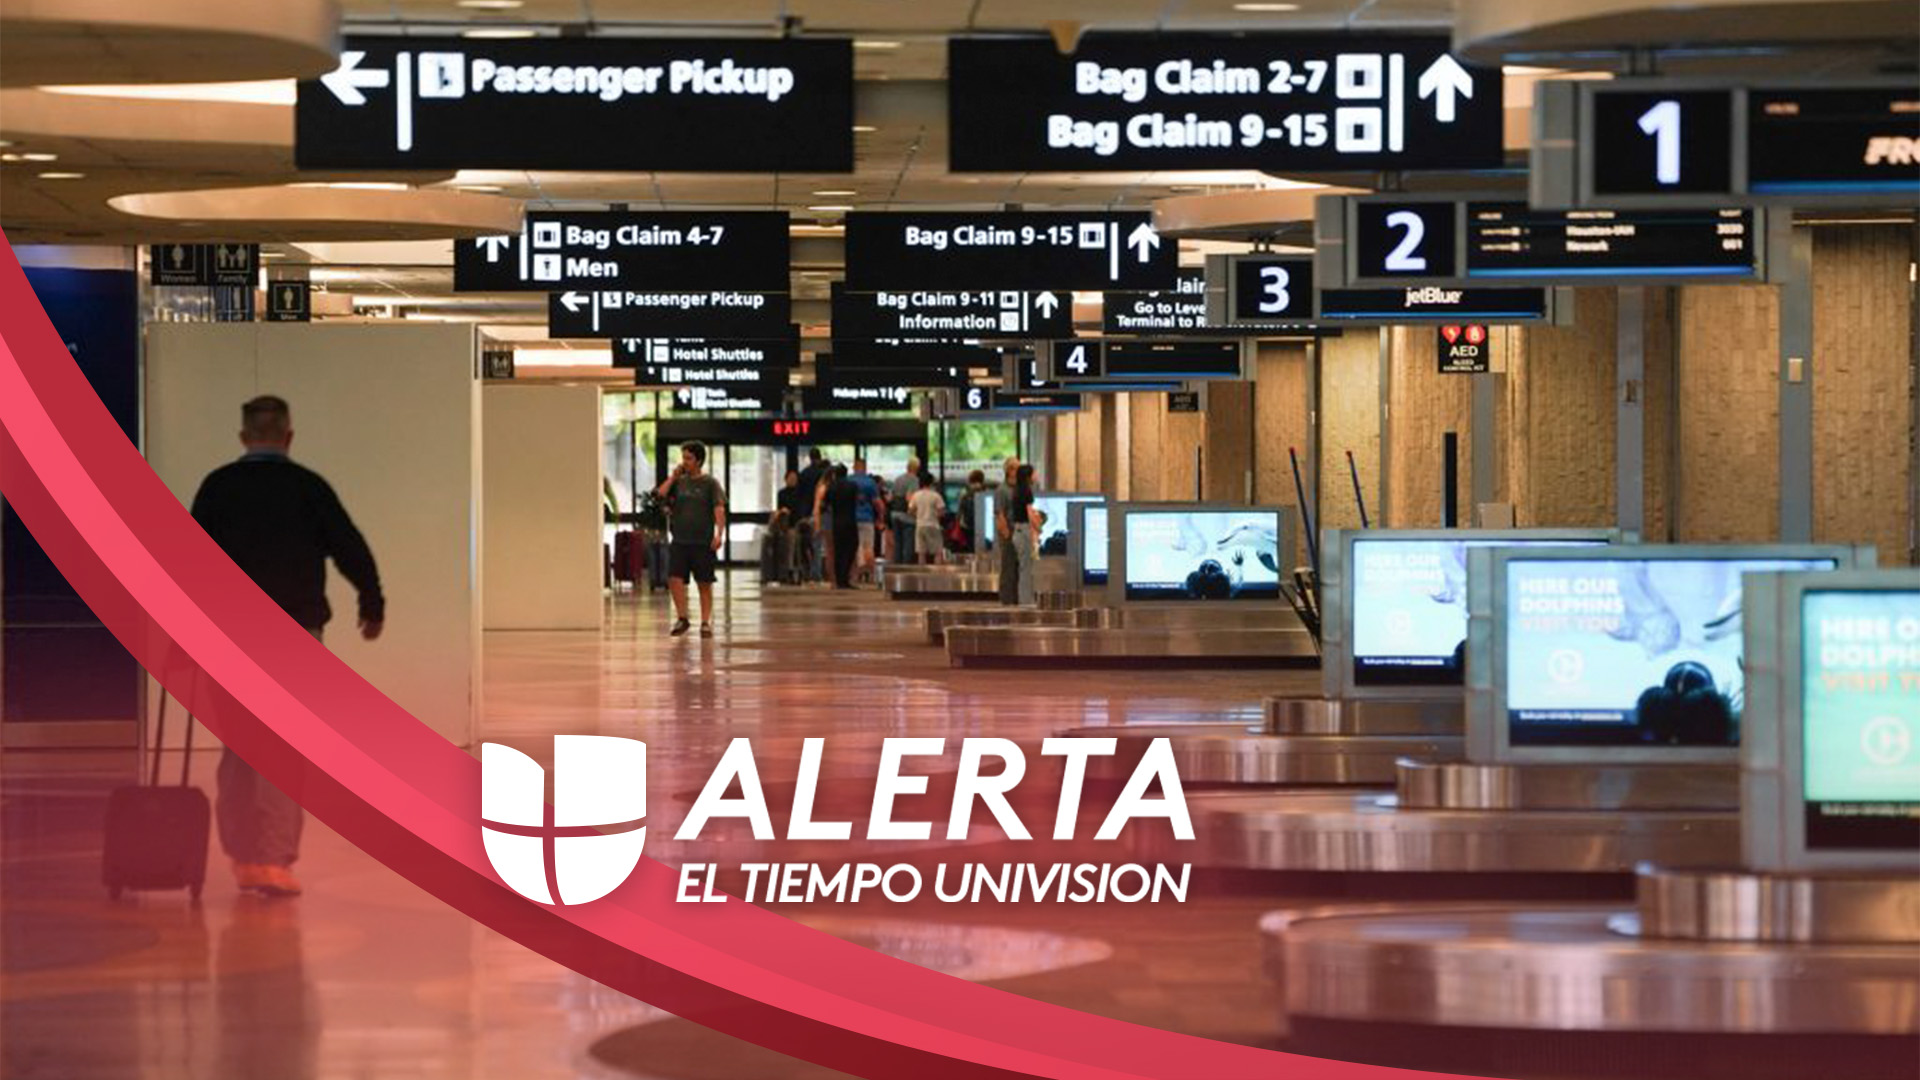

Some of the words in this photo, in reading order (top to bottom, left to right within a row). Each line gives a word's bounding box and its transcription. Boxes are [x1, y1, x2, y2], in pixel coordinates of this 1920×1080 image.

[471, 58, 664, 101] Passenger
[669, 58, 794, 102] Pickup
[1075, 61, 1148, 102] Bag
[1154, 59, 1261, 94] Claim
[1267, 60, 1329, 94] 2-7
[1047, 114, 1120, 155] Bag
[1126, 112, 1233, 148] Claim
[1238, 113, 1328, 148] 9-15
[1637, 100, 1681, 184] 1
[566, 226, 611, 250] Bag
[616, 224, 682, 246] Claim
[686, 225, 724, 246] 4-7
[905, 226, 948, 250] Bag
[953, 224, 1016, 246] Claim
[1020, 225, 1074, 246] 9-15
[1384, 210, 1427, 271] 2
[566, 257, 619, 278] Men
[625, 291, 708, 308] Passenger
[710, 291, 765, 309] Pickup
[877, 291, 908, 308] Bag
[911, 291, 957, 307] Claim
[959, 292, 996, 307] 9-11
[1259, 266, 1290, 313] 3
[1404, 287, 1462, 307] jetBlue
[1134, 301, 1155, 314] Go
[1157, 302, 1172, 314] to
[1174, 302, 1206, 315] Leve
[899, 313, 997, 331] Information
[1116, 315, 1175, 328] Terminal
[1178, 317, 1194, 328] to
[672, 347, 709, 361] Hotel
[710, 347, 764, 362] Shuttles
[1066, 345, 1088, 374] 4
[1449, 345, 1479, 357] AED
[684, 368, 714, 381] Hotel
[715, 368, 760, 381] Shuttles
[967, 387, 982, 409] 6
[774, 421, 810, 434] EXIT
[1519, 578, 1569, 595] HERE
[1574, 577, 1619, 595] OUR
[1519, 597, 1624, 614] DOLPHINS
[1820, 616, 1890, 641] HERE
[1820, 647, 1920, 669] DOLPH
